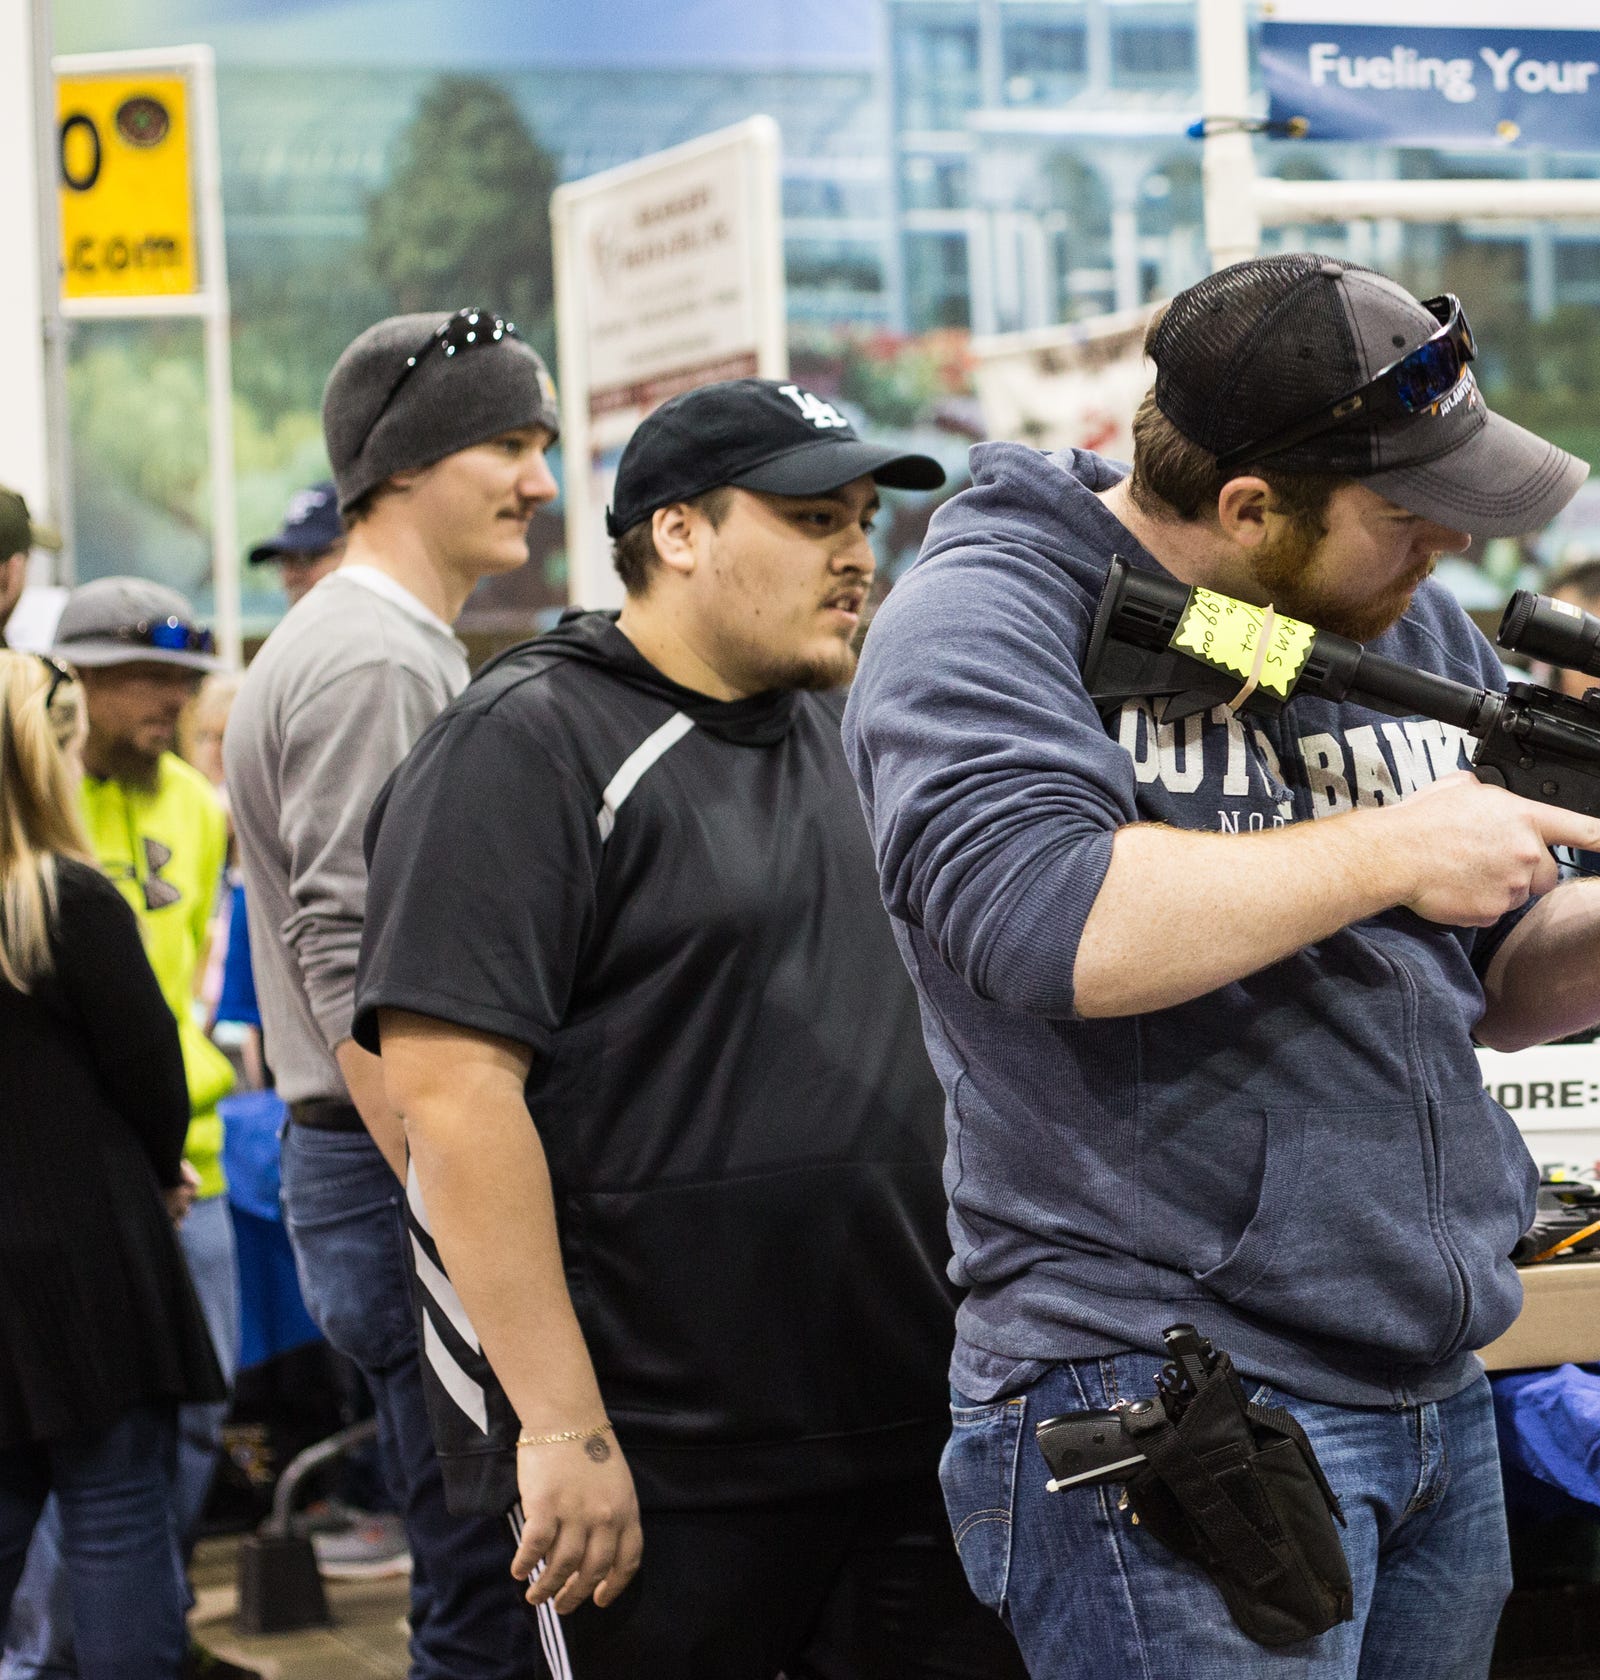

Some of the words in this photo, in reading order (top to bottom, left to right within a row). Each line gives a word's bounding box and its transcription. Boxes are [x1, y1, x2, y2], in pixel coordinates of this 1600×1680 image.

[1308, 42, 1475, 102] Fueling
[1480, 47, 1598, 96] Your
[1299, 719, 1480, 820] BANK
